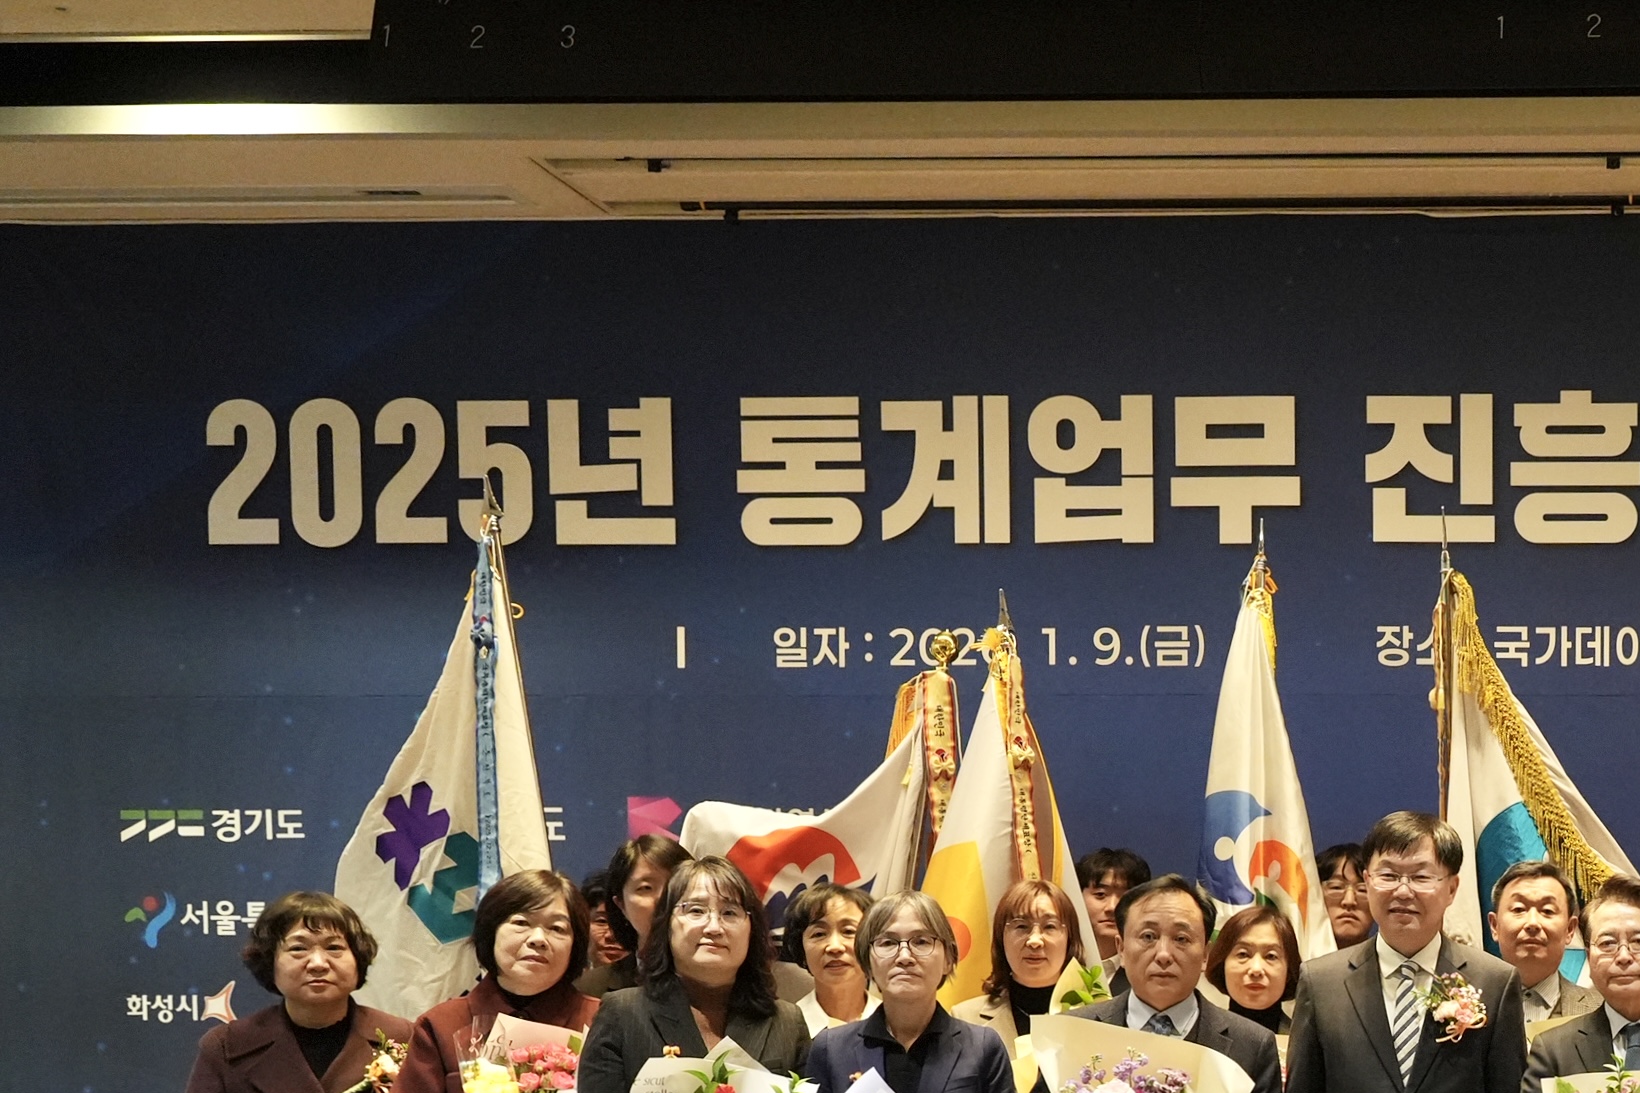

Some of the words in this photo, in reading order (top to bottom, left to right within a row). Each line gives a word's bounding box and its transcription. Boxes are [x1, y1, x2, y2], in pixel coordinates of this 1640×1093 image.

[383, 24, 391, 48] 1
[469, 24, 486, 49] 2
[560, 24, 576, 49] 3
[1497, 15, 1504, 39] 1
[1586, 13, 1602, 38] 2
[206, 397, 677, 548] 2025년
[736, 394, 1301, 546] 통계업무
[773, 626, 850, 668] 일자
[889, 627, 996, 667] 202
[211, 808, 306, 843] 경기도
[126, 994, 199, 1024] 화성시
